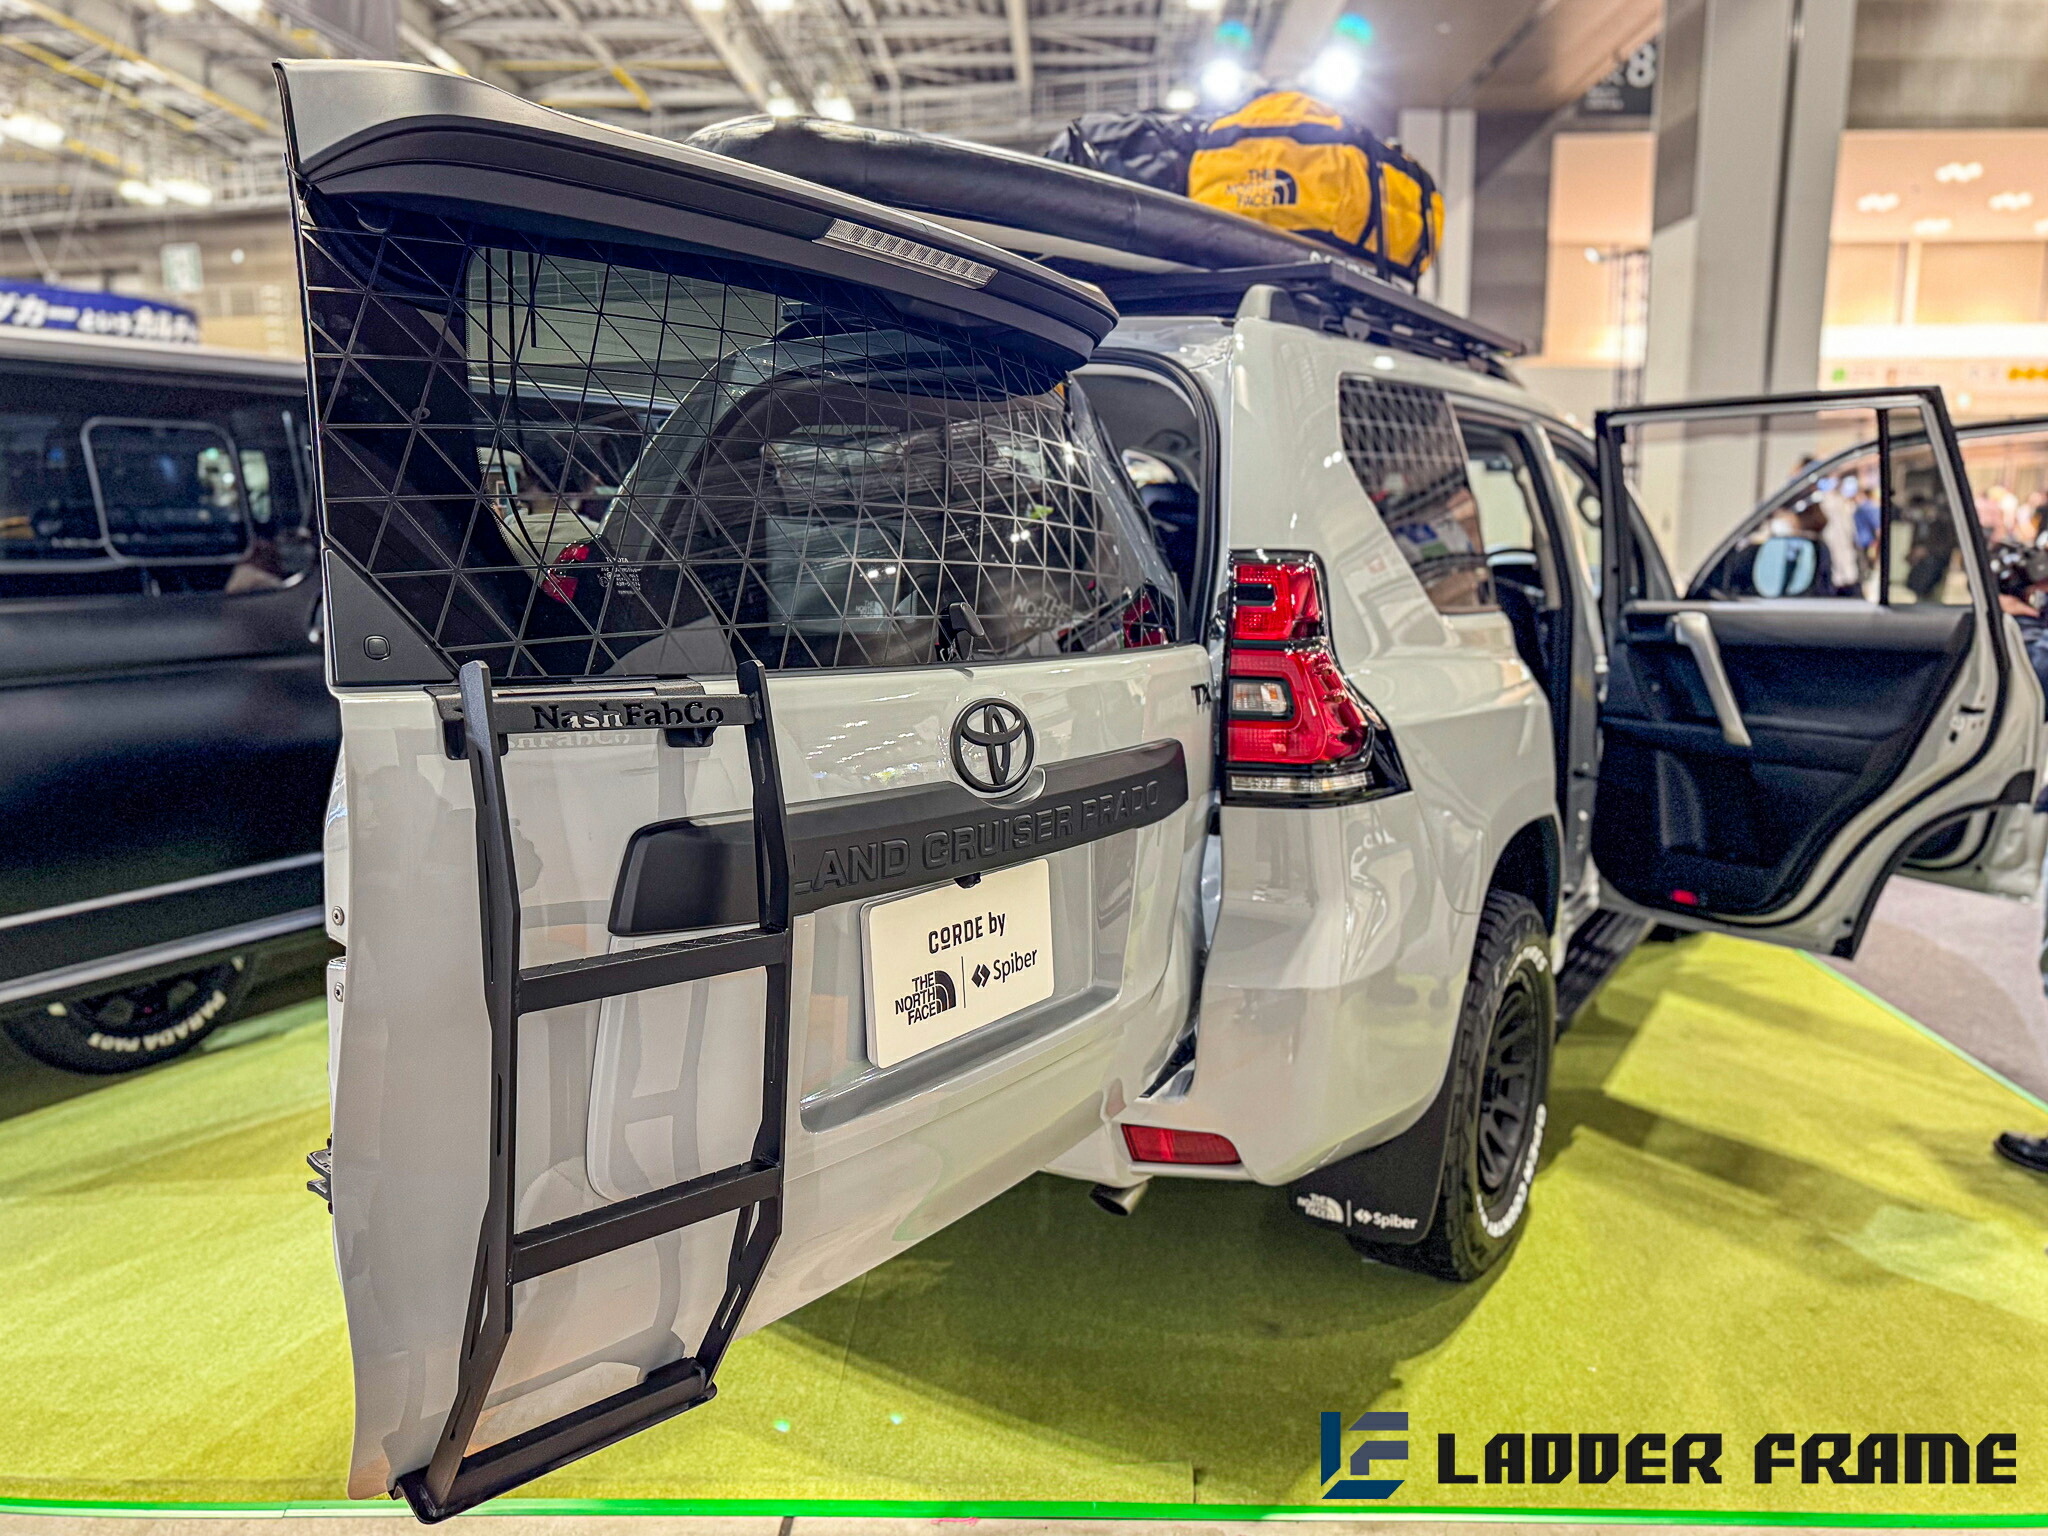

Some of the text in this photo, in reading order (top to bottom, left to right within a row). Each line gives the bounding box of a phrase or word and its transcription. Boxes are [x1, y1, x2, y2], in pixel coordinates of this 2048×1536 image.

[1248, 168, 1273, 182] THE
[1237, 193, 1274, 208] FACE
[1191, 682, 1212, 706] TX
[530, 701, 724, 731] NashFabCo
[923, 805, 1073, 871] CRUISER
[1081, 779, 1159, 832] PRADO
[988, 911, 1006, 937] by
[993, 949, 1038, 983] Spiber
[912, 971, 935, 992] THE
[895, 986, 936, 1015] NORTH
[907, 1001, 938, 1026] FACE
[1373, 1211, 1418, 1230] Spiber
